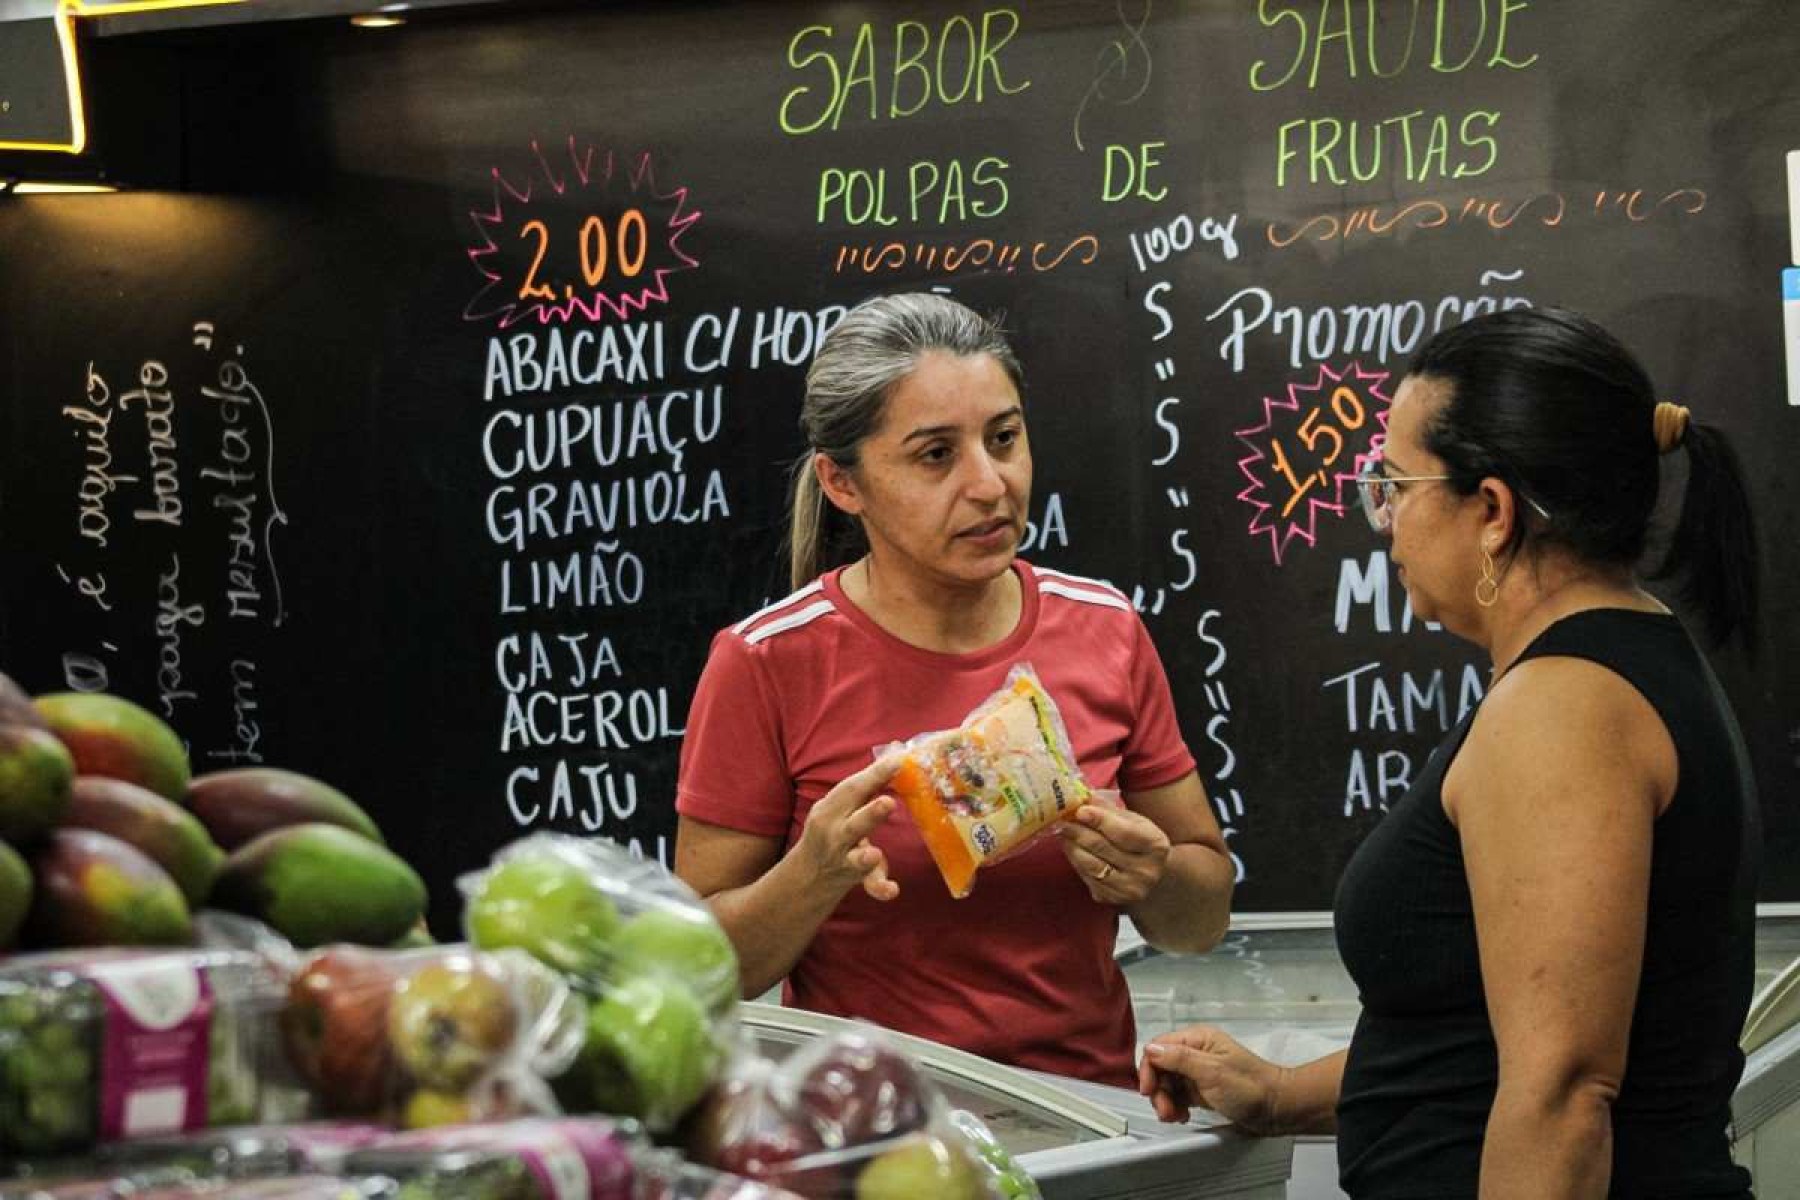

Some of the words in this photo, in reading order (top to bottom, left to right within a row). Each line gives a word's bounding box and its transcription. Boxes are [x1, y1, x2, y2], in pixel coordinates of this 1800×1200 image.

[779, 9, 1031, 135] SABOR
[817, 156, 1010, 226] POLPAS
[1101, 142, 1169, 202] DE
[1277, 111, 1502, 187] FRUTAS
[484, 321, 665, 402] ABACAXI
[684, 305, 741, 373] C/
[1205, 266, 1533, 373] Promo
[62, 360, 140, 547] aquilo
[119, 360, 183, 526] barato
[482, 384, 722, 480] CUPUAÇU
[1271, 386, 1366, 518] 1,50
[486, 469, 731, 552] GRAVIOLA
[501, 539, 644, 614] LIMÃO
[155, 552, 206, 717] paga
[496, 631, 623, 693] CAJA
[207, 659, 264, 763] tem
[506, 759, 637, 830] CAJU
